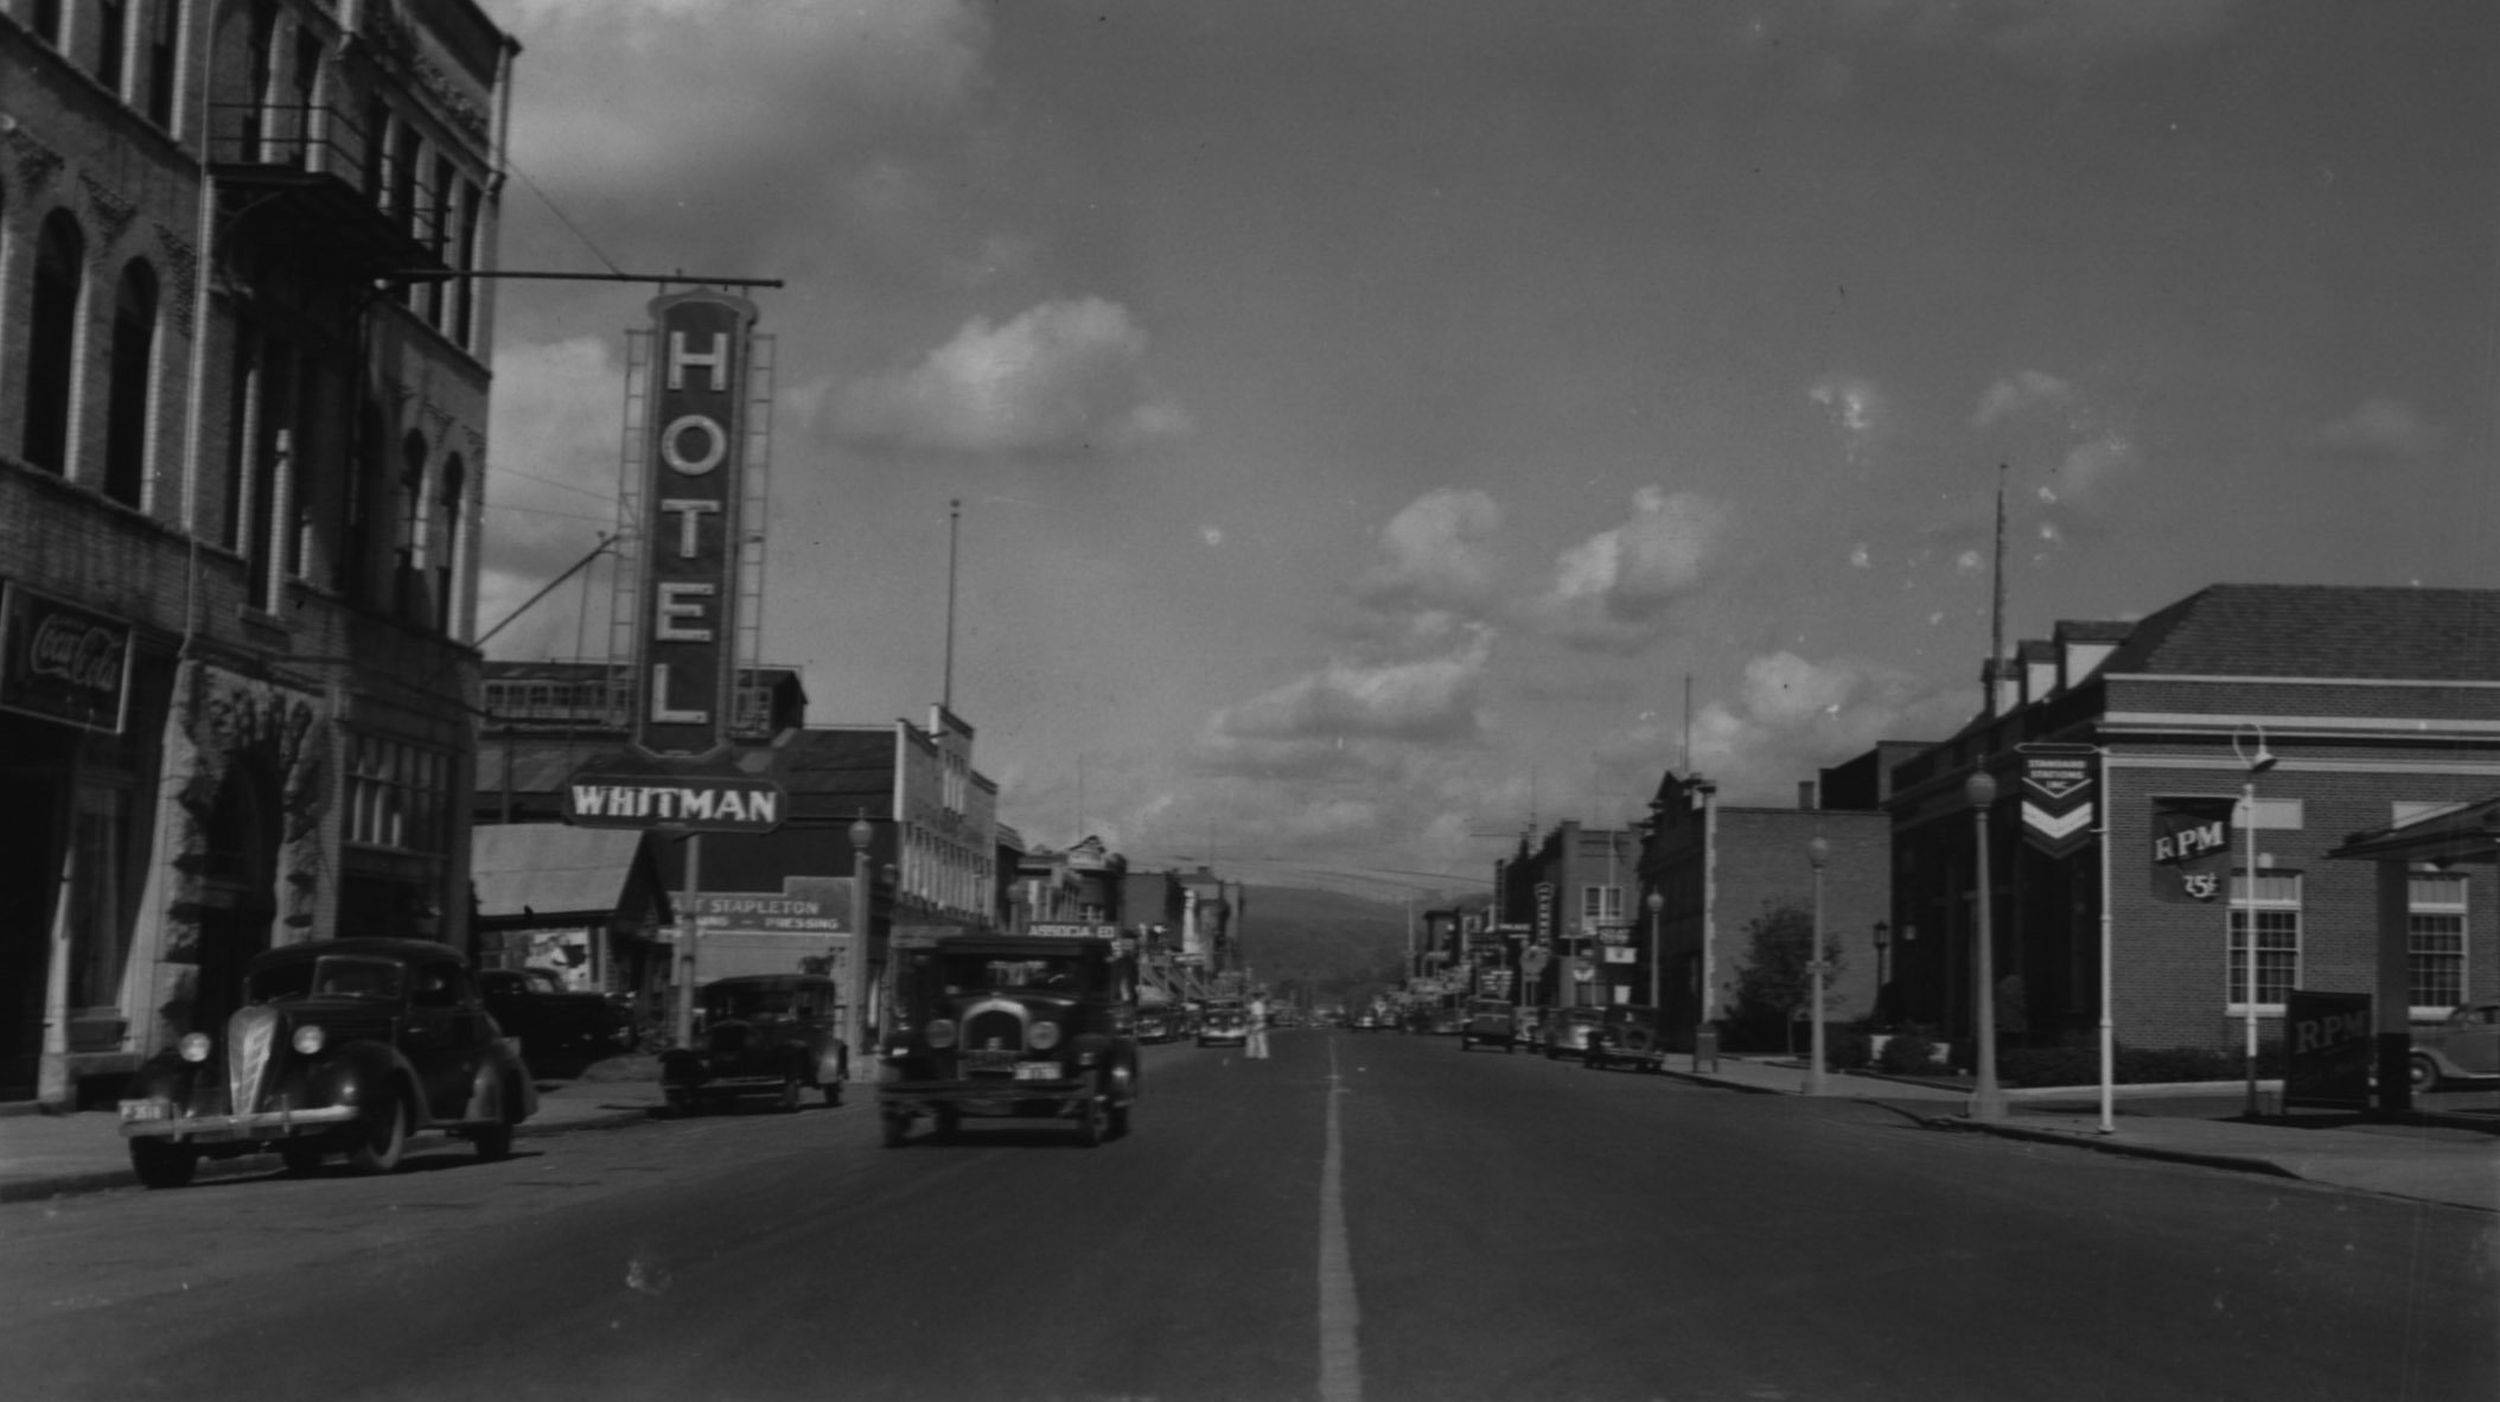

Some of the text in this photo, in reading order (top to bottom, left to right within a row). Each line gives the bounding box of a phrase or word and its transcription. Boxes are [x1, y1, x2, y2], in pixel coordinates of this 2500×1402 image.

[653, 330, 729, 725] HOTEL
[572, 785, 777, 823] WHITMAN
[2154, 821, 2225, 861] RPM
[711, 899, 820, 916] STAPLETON
[764, 917, 840, 930] PRESSING
[2295, 1010, 2368, 1055] RPM
